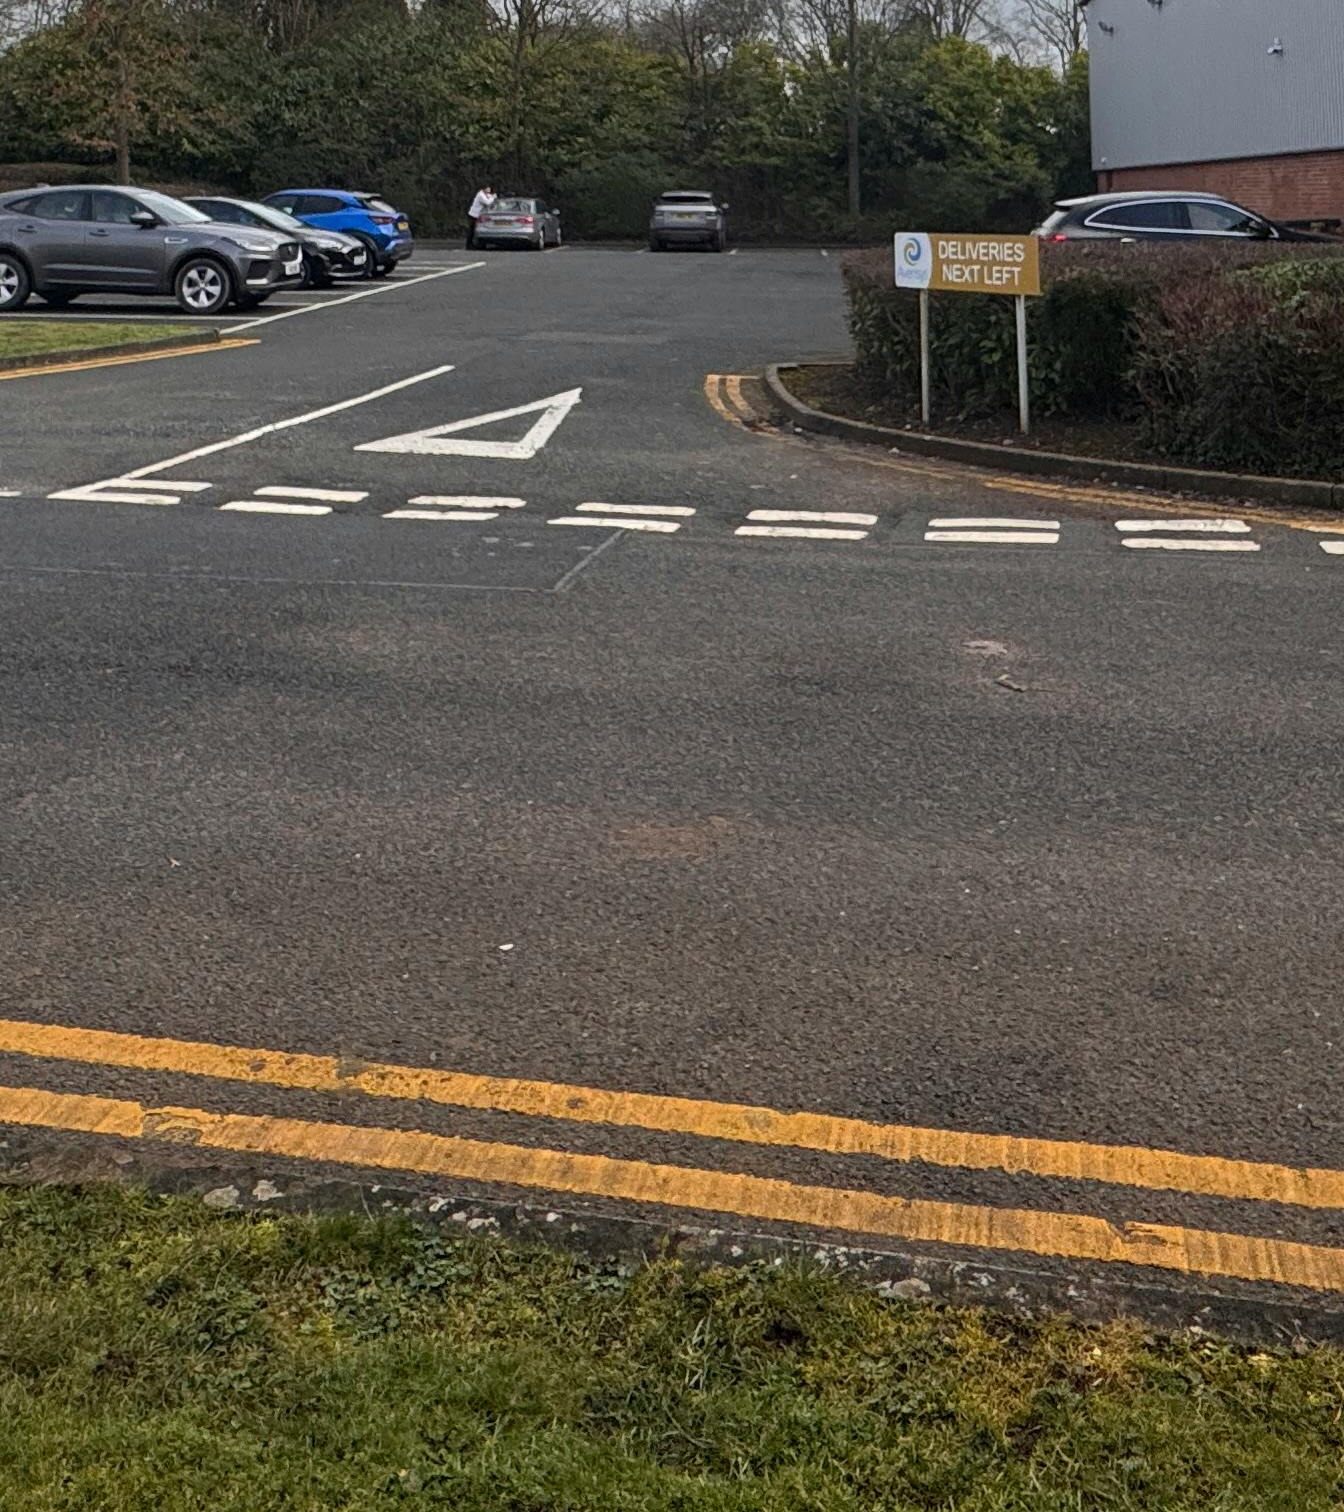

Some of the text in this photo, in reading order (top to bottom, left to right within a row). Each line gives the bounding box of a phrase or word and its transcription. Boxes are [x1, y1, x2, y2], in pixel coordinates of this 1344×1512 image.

[938, 240, 1025, 263] DELIVERIES
[942, 264, 1022, 286] NEXT LEFT
